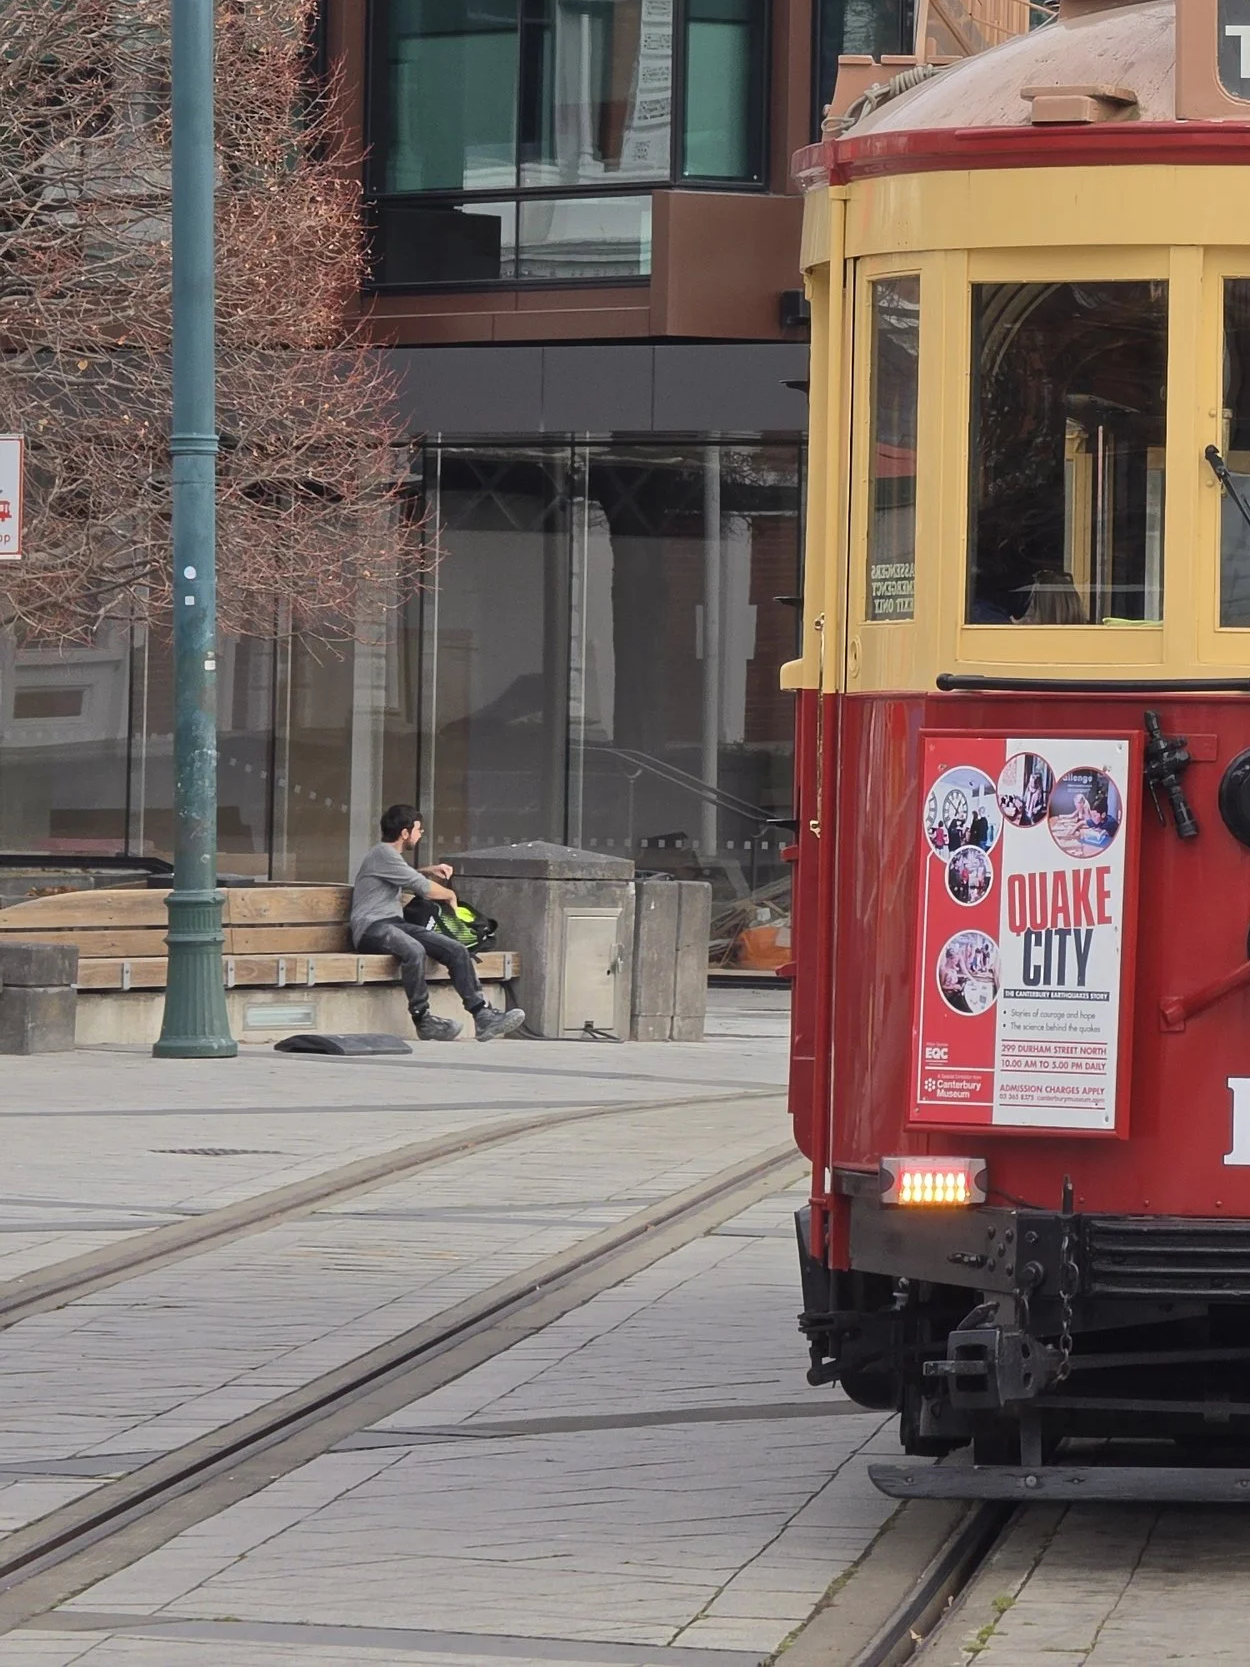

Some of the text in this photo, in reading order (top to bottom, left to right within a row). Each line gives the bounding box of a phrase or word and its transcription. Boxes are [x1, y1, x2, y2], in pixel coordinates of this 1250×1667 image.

[1008, 866, 1112, 936] QUAKE
[1023, 928, 1093, 986] CITY
[1066, 1011, 1078, 1019] and
[1080, 1011, 1095, 1021] hope
[1011, 1022, 1021, 1030] The
[1068, 1023, 1078, 1031] the
[925, 1047, 948, 1059] EQC
[1002, 1044, 1106, 1055] 299 DURHAM STREET NORTH
[1024, 1060, 1037, 1068] AM
[1040, 1060, 1049, 1068] TO
[1052, 1061, 1068, 1069] 5.00
[1071, 1062, 1082, 1070] PM
[1085, 1062, 1105, 1070] DAILY
[937, 1080, 981, 1091] Canterbury
[1000, 1084, 1105, 1095] ADMISSION CHARGES APPLY
[936, 1089, 970, 1098] Museum
